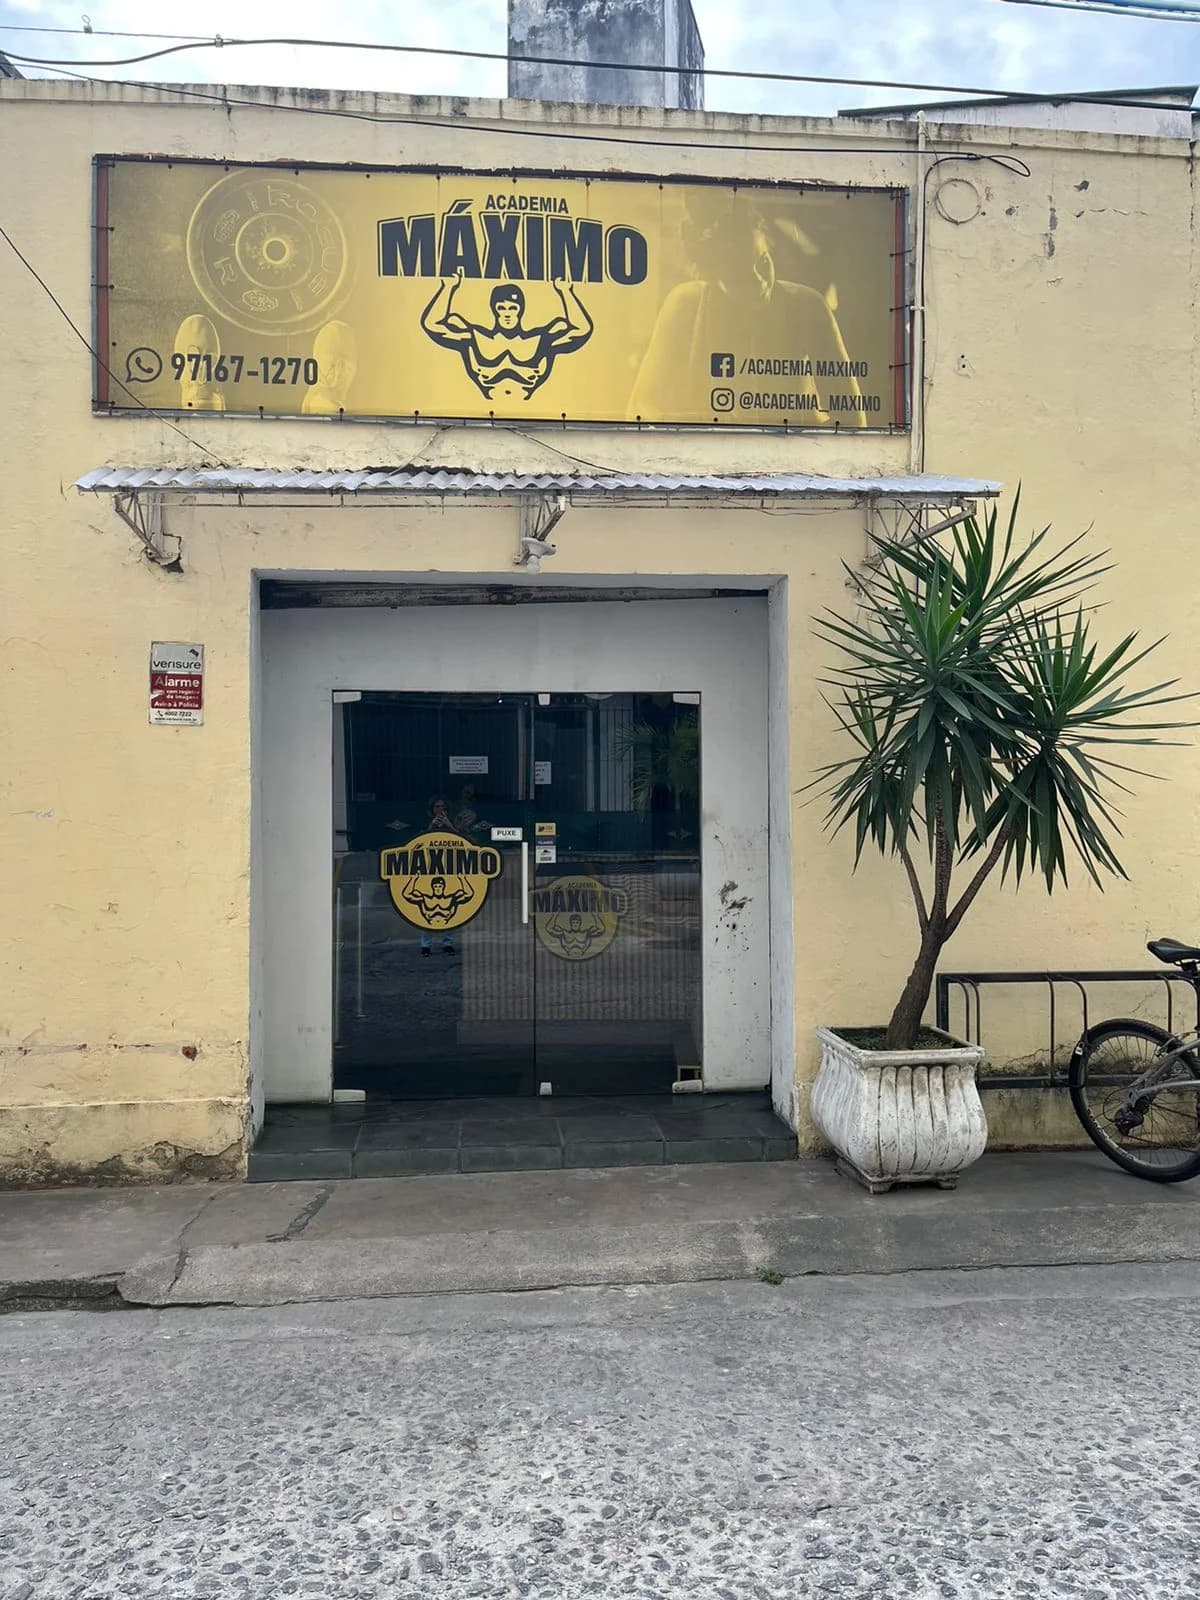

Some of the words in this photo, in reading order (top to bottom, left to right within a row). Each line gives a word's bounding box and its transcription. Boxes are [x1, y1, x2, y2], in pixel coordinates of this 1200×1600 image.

[485, 194, 569, 214] ACADEMIA
[378, 199, 648, 286] MÁXIMO
[171, 352, 319, 386] 97167-1270
[740, 358, 813, 376] /ACADEMIA
[816, 360, 868, 378] MAXIMO
[739, 391, 881, 413] @ACADEMIA_MAXIMO
[153, 660, 201, 669] verisure
[155, 675, 200, 688] Alarme
[386, 843, 497, 876] MÁXIMO
